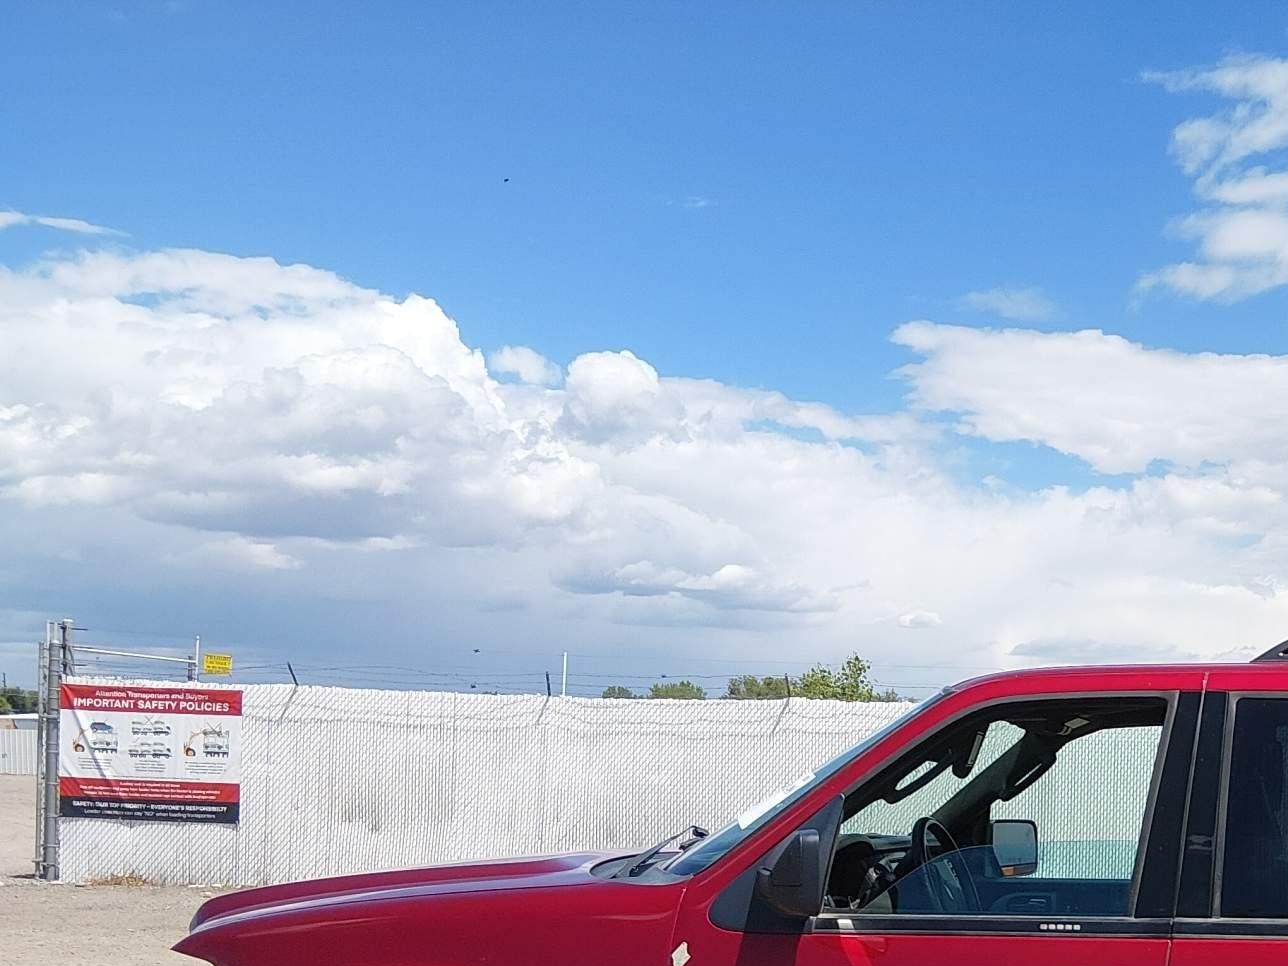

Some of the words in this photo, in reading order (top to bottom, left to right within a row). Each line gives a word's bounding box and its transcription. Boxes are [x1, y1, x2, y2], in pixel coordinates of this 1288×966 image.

[73, 697, 135, 709] IMPORTANT
[137, 700, 177, 710] SAFETY
[179, 701, 230, 712] POLICIES
